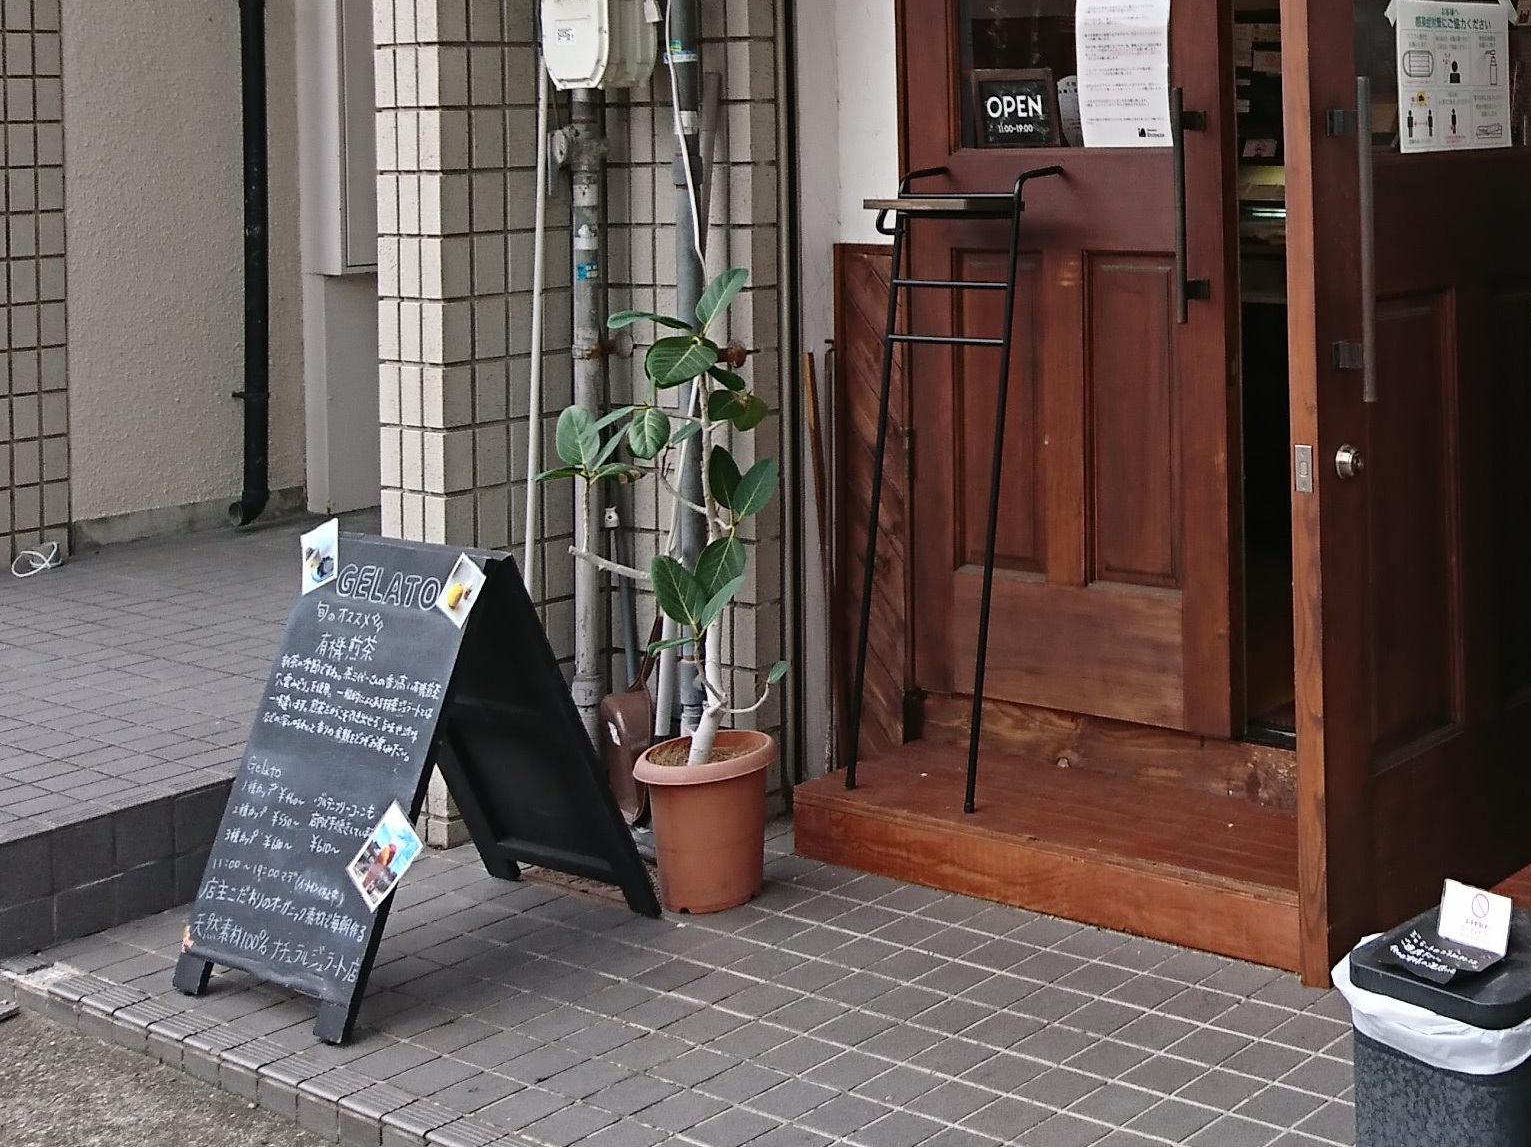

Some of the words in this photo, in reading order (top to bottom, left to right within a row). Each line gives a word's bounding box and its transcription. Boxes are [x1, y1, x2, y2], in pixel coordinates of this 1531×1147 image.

[986, 94, 1043, 118] OPEN
[336, 564, 441, 611] GELATO
[315, 632, 378, 661] 有機煎茶
[247, 756, 282, 778] Gelato
